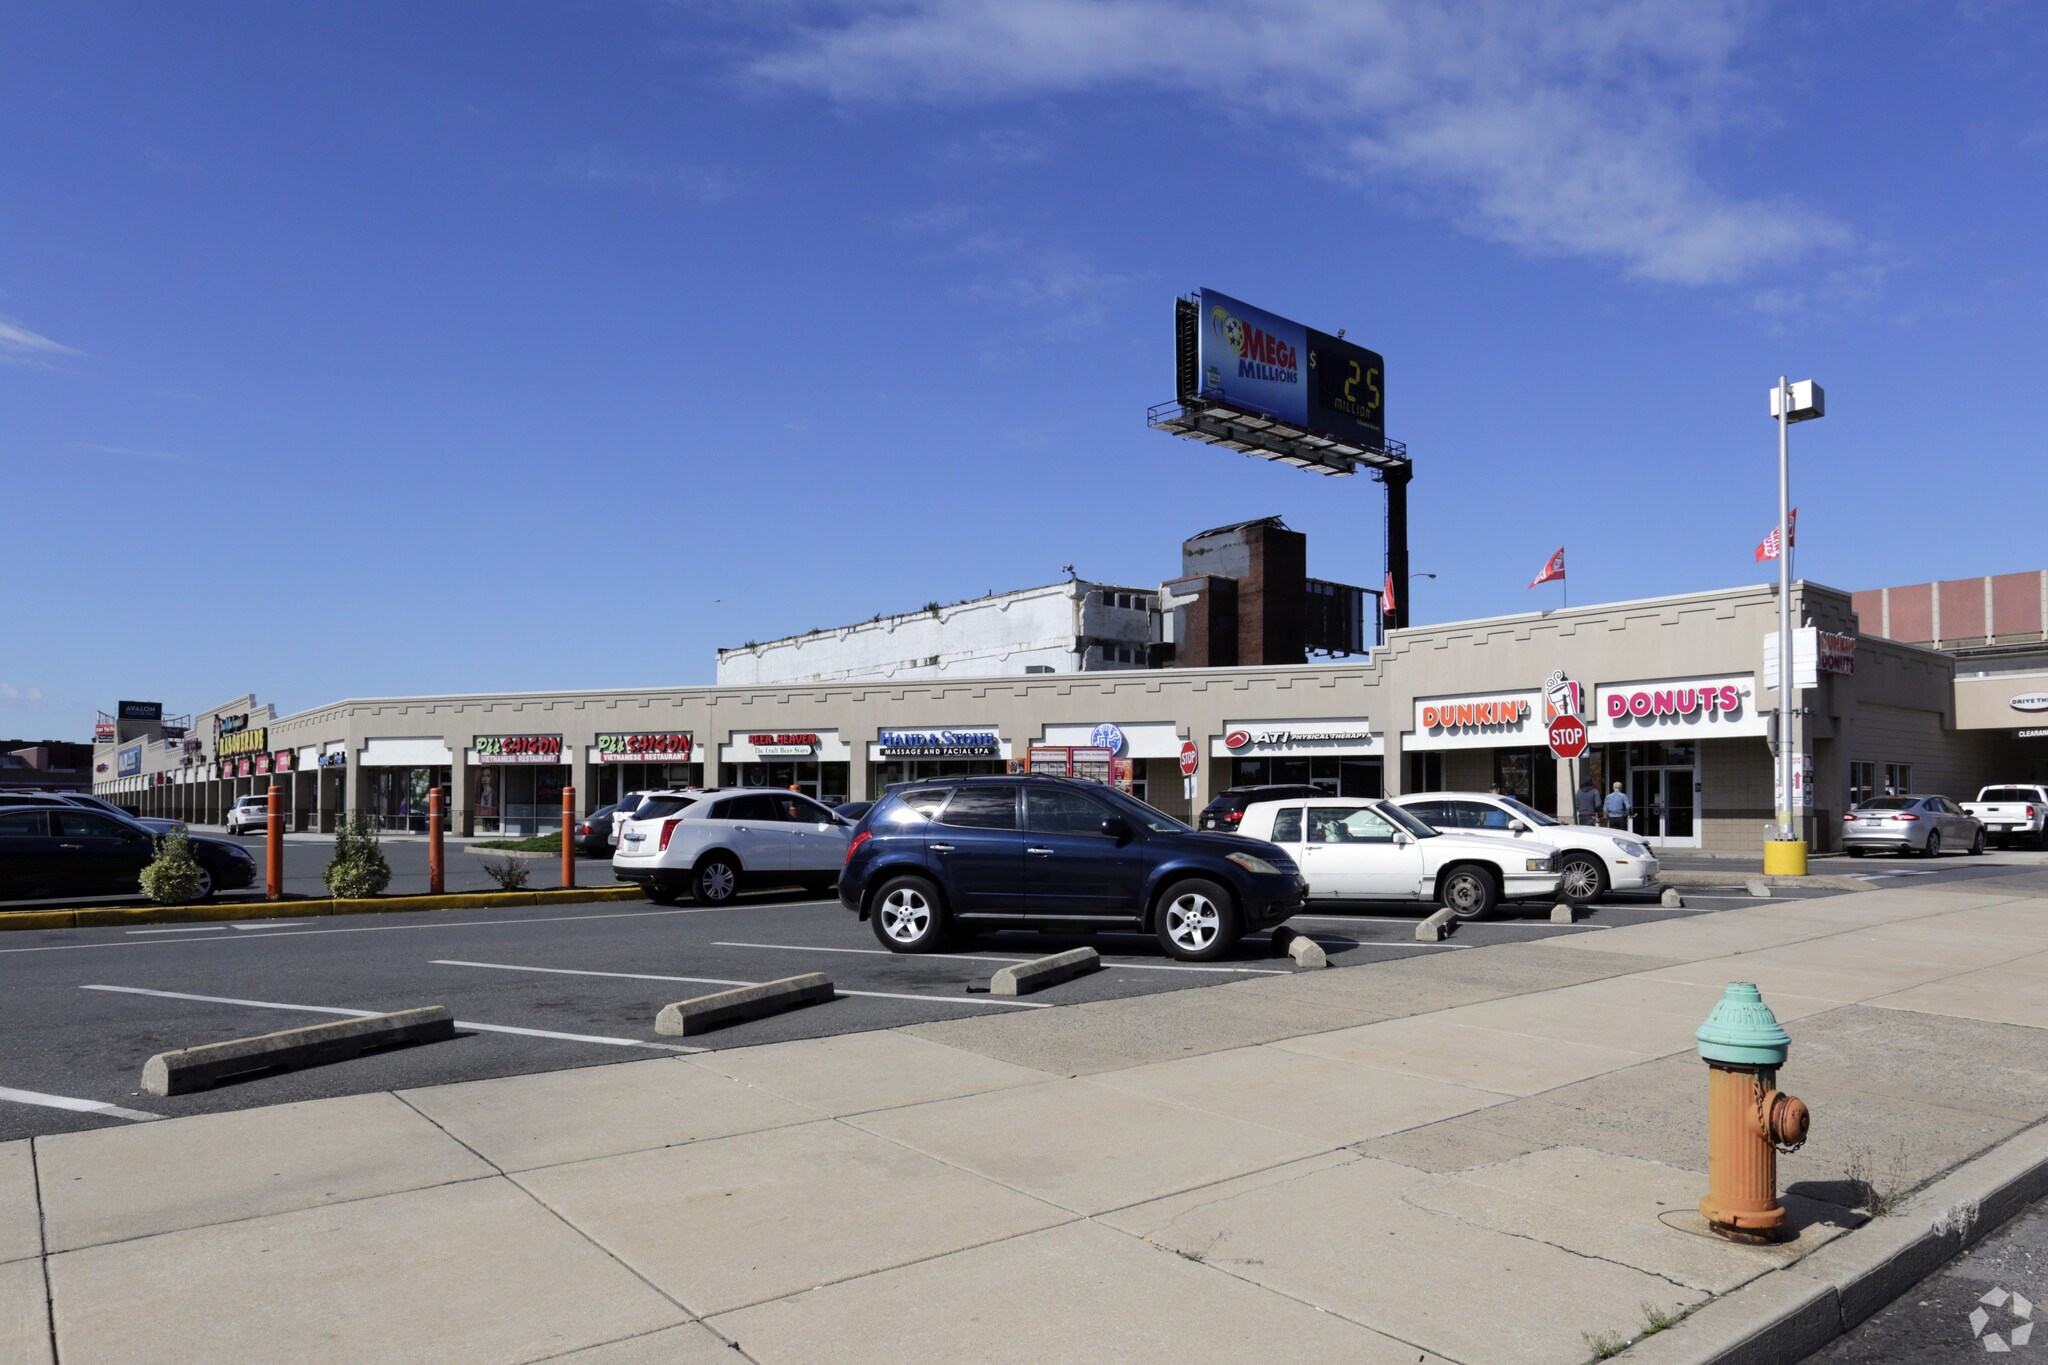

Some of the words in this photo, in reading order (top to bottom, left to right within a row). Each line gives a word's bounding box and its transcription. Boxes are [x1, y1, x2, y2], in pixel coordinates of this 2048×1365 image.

[1240, 320, 1298, 371] MEGA
[1238, 359, 1298, 384] MILLIONS
[1344, 360, 1381, 409] 25
[1334, 397, 1372, 419] MILLION
[1822, 654, 1856, 675] DONUTS
[1607, 685, 1738, 718] DONUTS
[1423, 699, 1528, 728] DUNKIN'
[502, 736, 560, 754] SAIGON
[627, 734, 692, 752] SAIGON
[748, 734, 773, 744] BEER
[777, 733, 816, 744] HEAVEN
[881, 731, 926, 746] HAND
[927, 733, 940, 746] &
[941, 730, 994, 746] STONE
[1254, 731, 1290, 744] ATI
[1552, 728, 1583, 746] STOP
[481, 755, 516, 763] VIETNAMESE
[517, 754, 556, 762] RESTAURANT
[604, 753, 642, 761] VIETNAMESE
[1181, 751, 1196, 766] STOP
